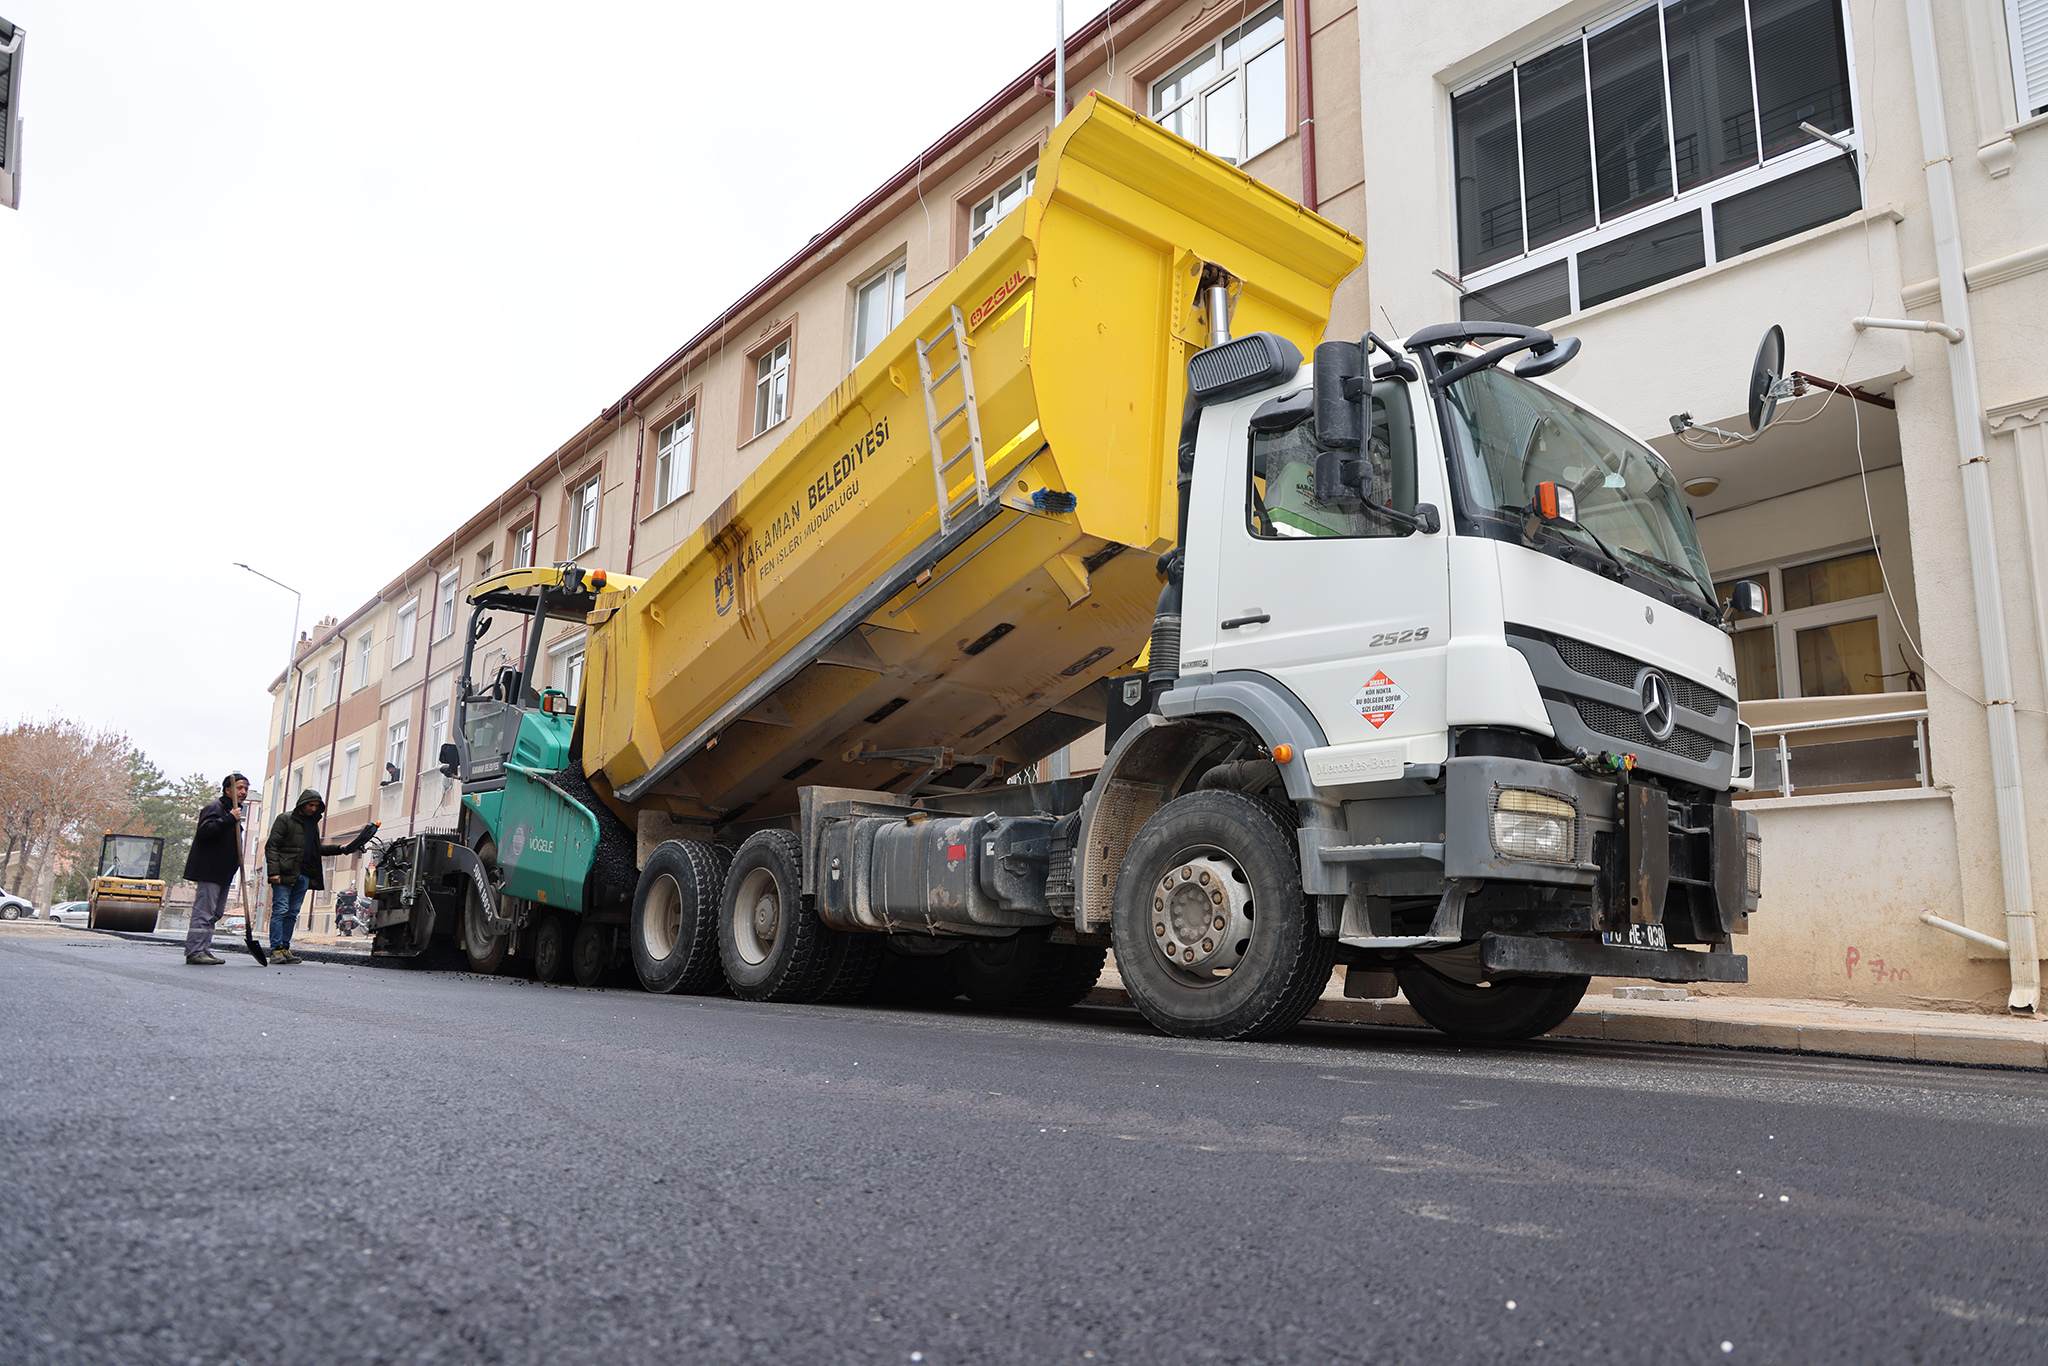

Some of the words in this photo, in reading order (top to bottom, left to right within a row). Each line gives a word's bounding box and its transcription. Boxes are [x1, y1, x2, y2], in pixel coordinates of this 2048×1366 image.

[737, 500, 800, 578] KARAMAN
[807, 416, 889, 511] BELEDİYESİ
[760, 557, 775, 580] FEN
[1369, 626, 1430, 647] 2529
[1316, 756, 1398, 775] Mercedes-Benz
[529, 835, 554, 853] VÖGELE
[1145, 812, 1254, 853] PIRELLI
[1629, 923, 1642, 945] HE
[1647, 925, 1664, 947] 038
[1845, 945, 1861, 981] P
